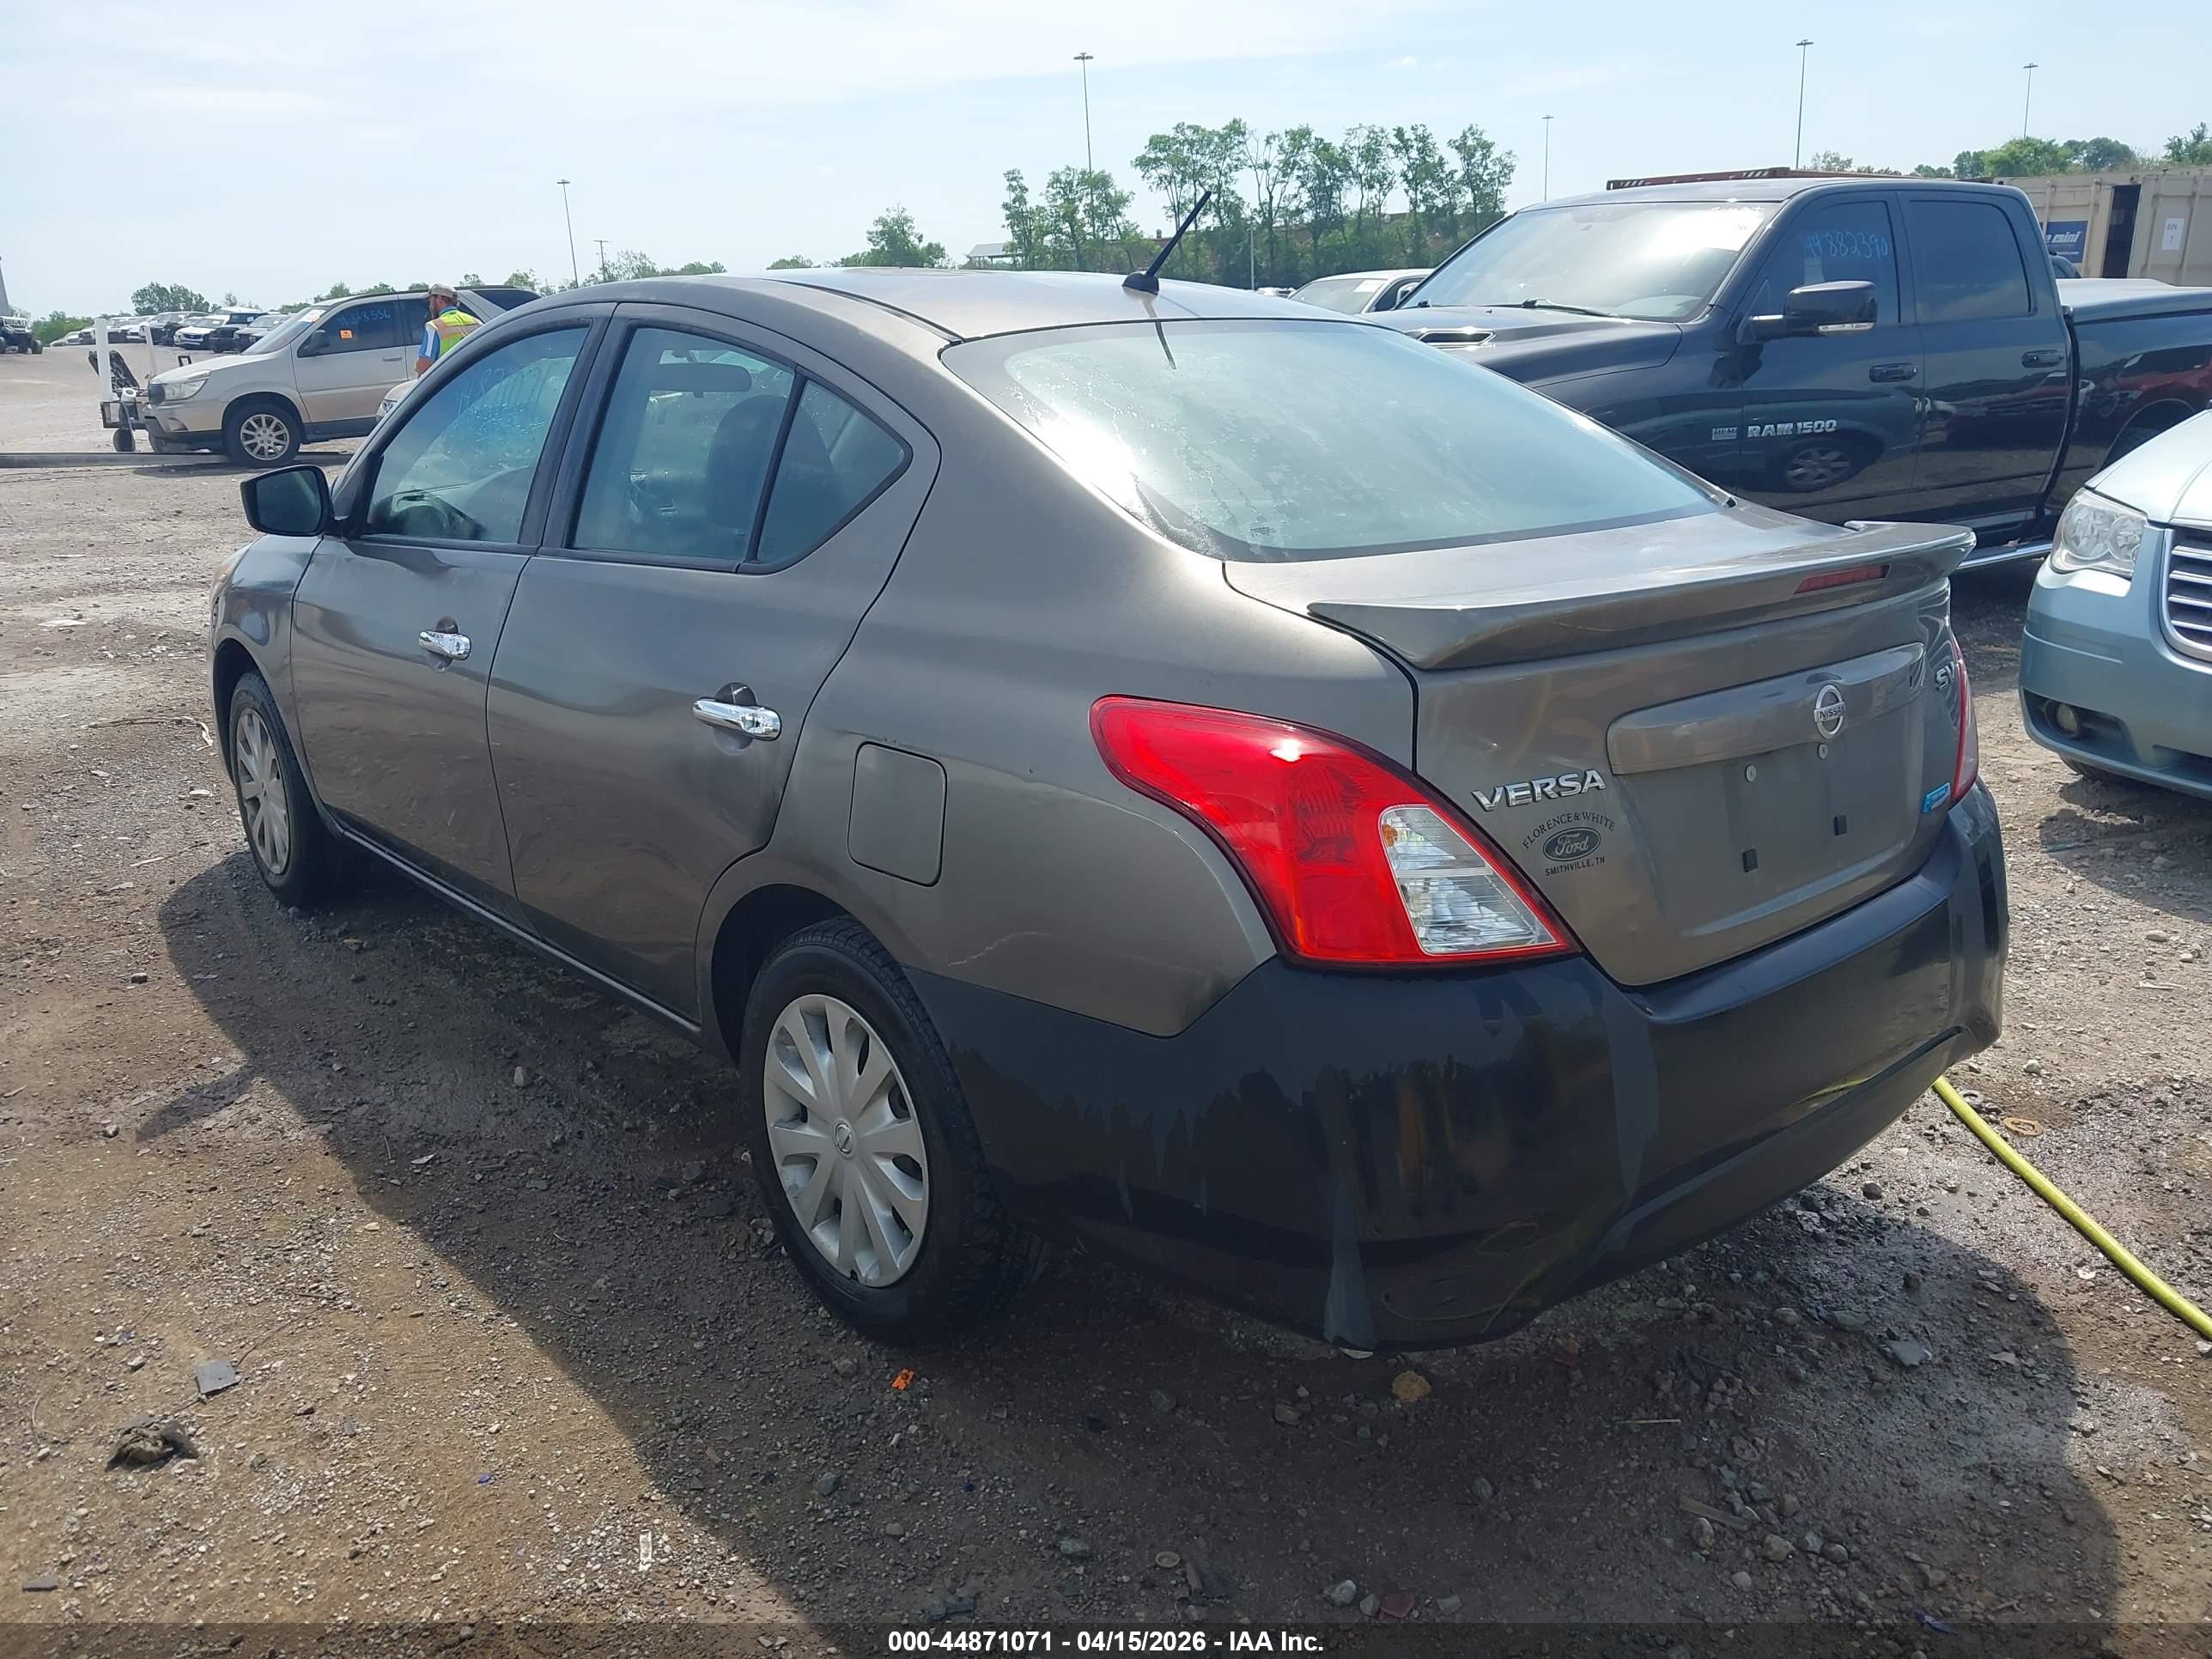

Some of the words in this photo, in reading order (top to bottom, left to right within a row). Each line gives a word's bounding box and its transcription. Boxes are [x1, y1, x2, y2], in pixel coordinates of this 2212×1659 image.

[1747, 422, 1793, 438] RAM
[1796, 419, 1837, 434] 1500
[1471, 769, 1606, 811] VERSA
[1555, 832, 1589, 856] Ford
[1595, 855, 1605, 865] TN
